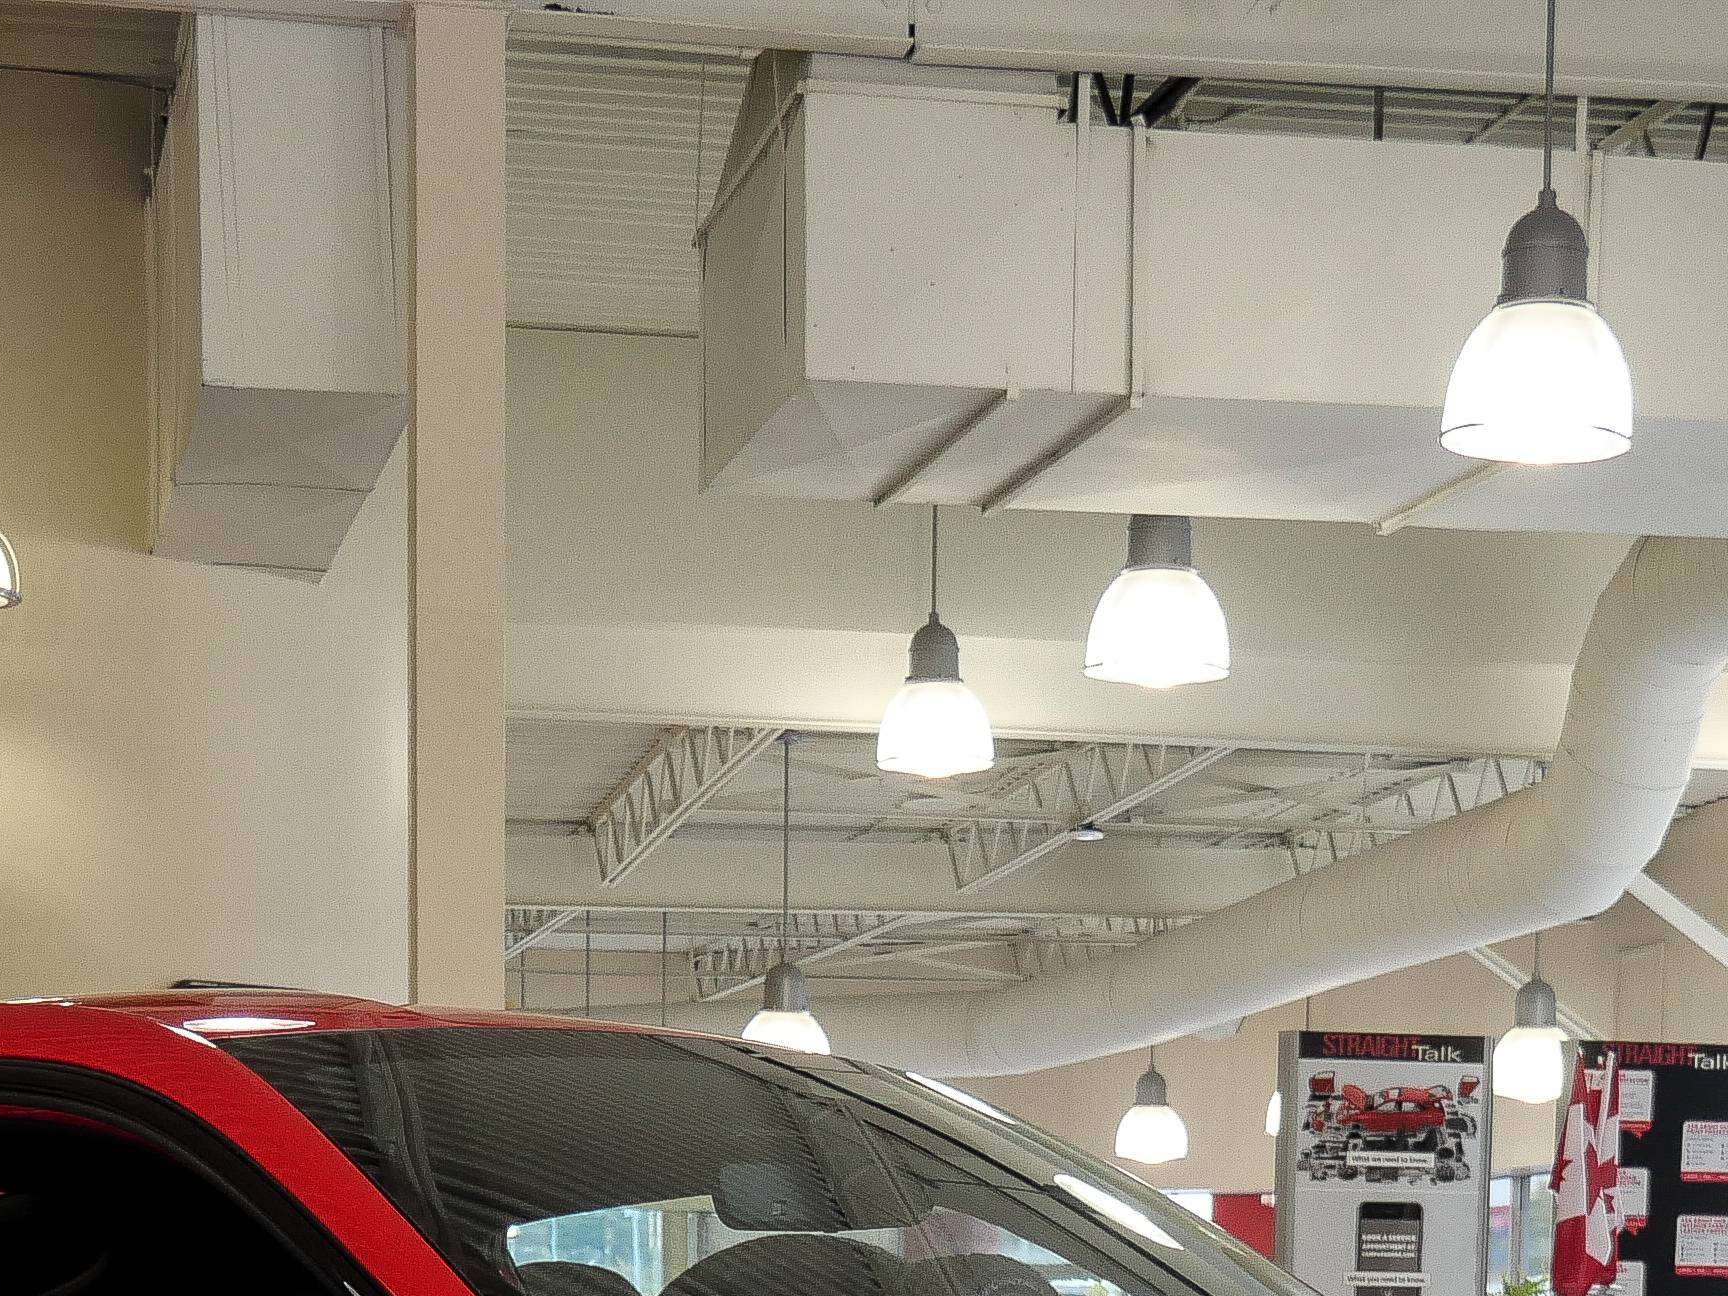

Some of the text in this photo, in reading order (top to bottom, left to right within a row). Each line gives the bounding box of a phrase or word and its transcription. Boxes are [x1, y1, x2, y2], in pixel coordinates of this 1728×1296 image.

[1322, 1032, 1462, 1063] STRAIGHT Talk
[1347, 1275, 1367, 1284] What
